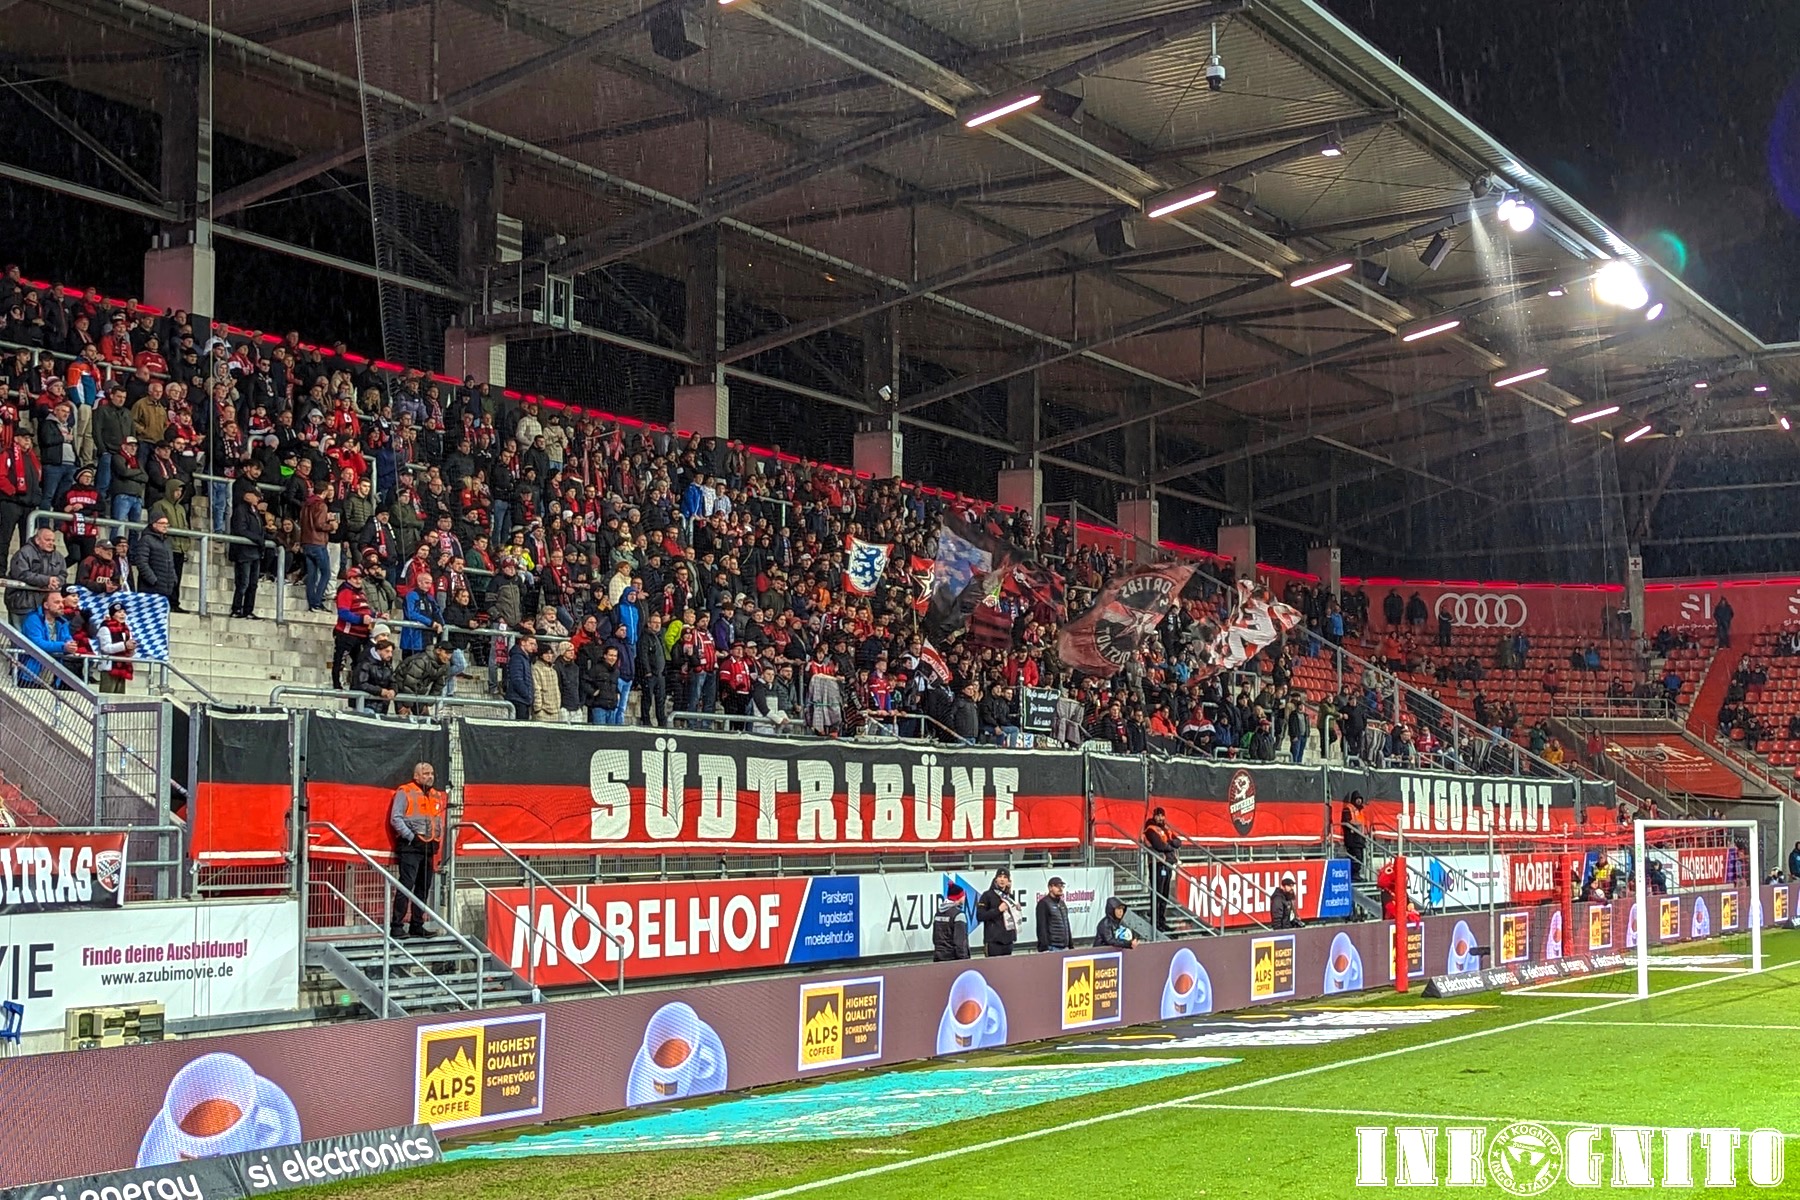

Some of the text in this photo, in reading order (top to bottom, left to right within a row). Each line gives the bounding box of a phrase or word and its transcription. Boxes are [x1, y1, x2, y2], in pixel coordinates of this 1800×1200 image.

[589, 737, 1020, 841] SÜDTRIBÜNE
[1400, 777, 1552, 832] INGOLSTADT
[0, 846, 93, 905] LTRAS
[821, 890, 854, 905] Parsberg
[818, 910, 854, 927] Ingolstadt
[511, 887, 780, 969] MÖBELHOF
[804, 930, 854, 947] moebelhof.de
[82, 938, 248, 966] Finde deine Ausbildung!
[101, 962, 233, 986] www.azubimovie.de
[1094, 967, 1118, 979] HIGHEST
[1255, 969, 1271, 983] ALPS
[1094, 979, 1118, 990] QUALITY
[1445, 973, 1484, 992] electronics
[845, 995, 878, 1008] HIGHEST
[1067, 992, 1090, 1009] ALPS
[845, 1008, 877, 1022] QUALITY
[1069, 1009, 1087, 1018] COFFEE
[805, 1025, 839, 1046] ALPS
[487, 1036, 537, 1054] HIGHEST
[808, 1045, 835, 1057] COFFEE
[487, 1053, 536, 1070] QUALITY
[486, 1070, 536, 1087] SCHREYÖGG
[425, 1075, 476, 1102] ALPS
[502, 1085, 521, 1097] 1890
[430, 1100, 470, 1116] COFFEE
[248, 1134, 433, 1188] si electronics
